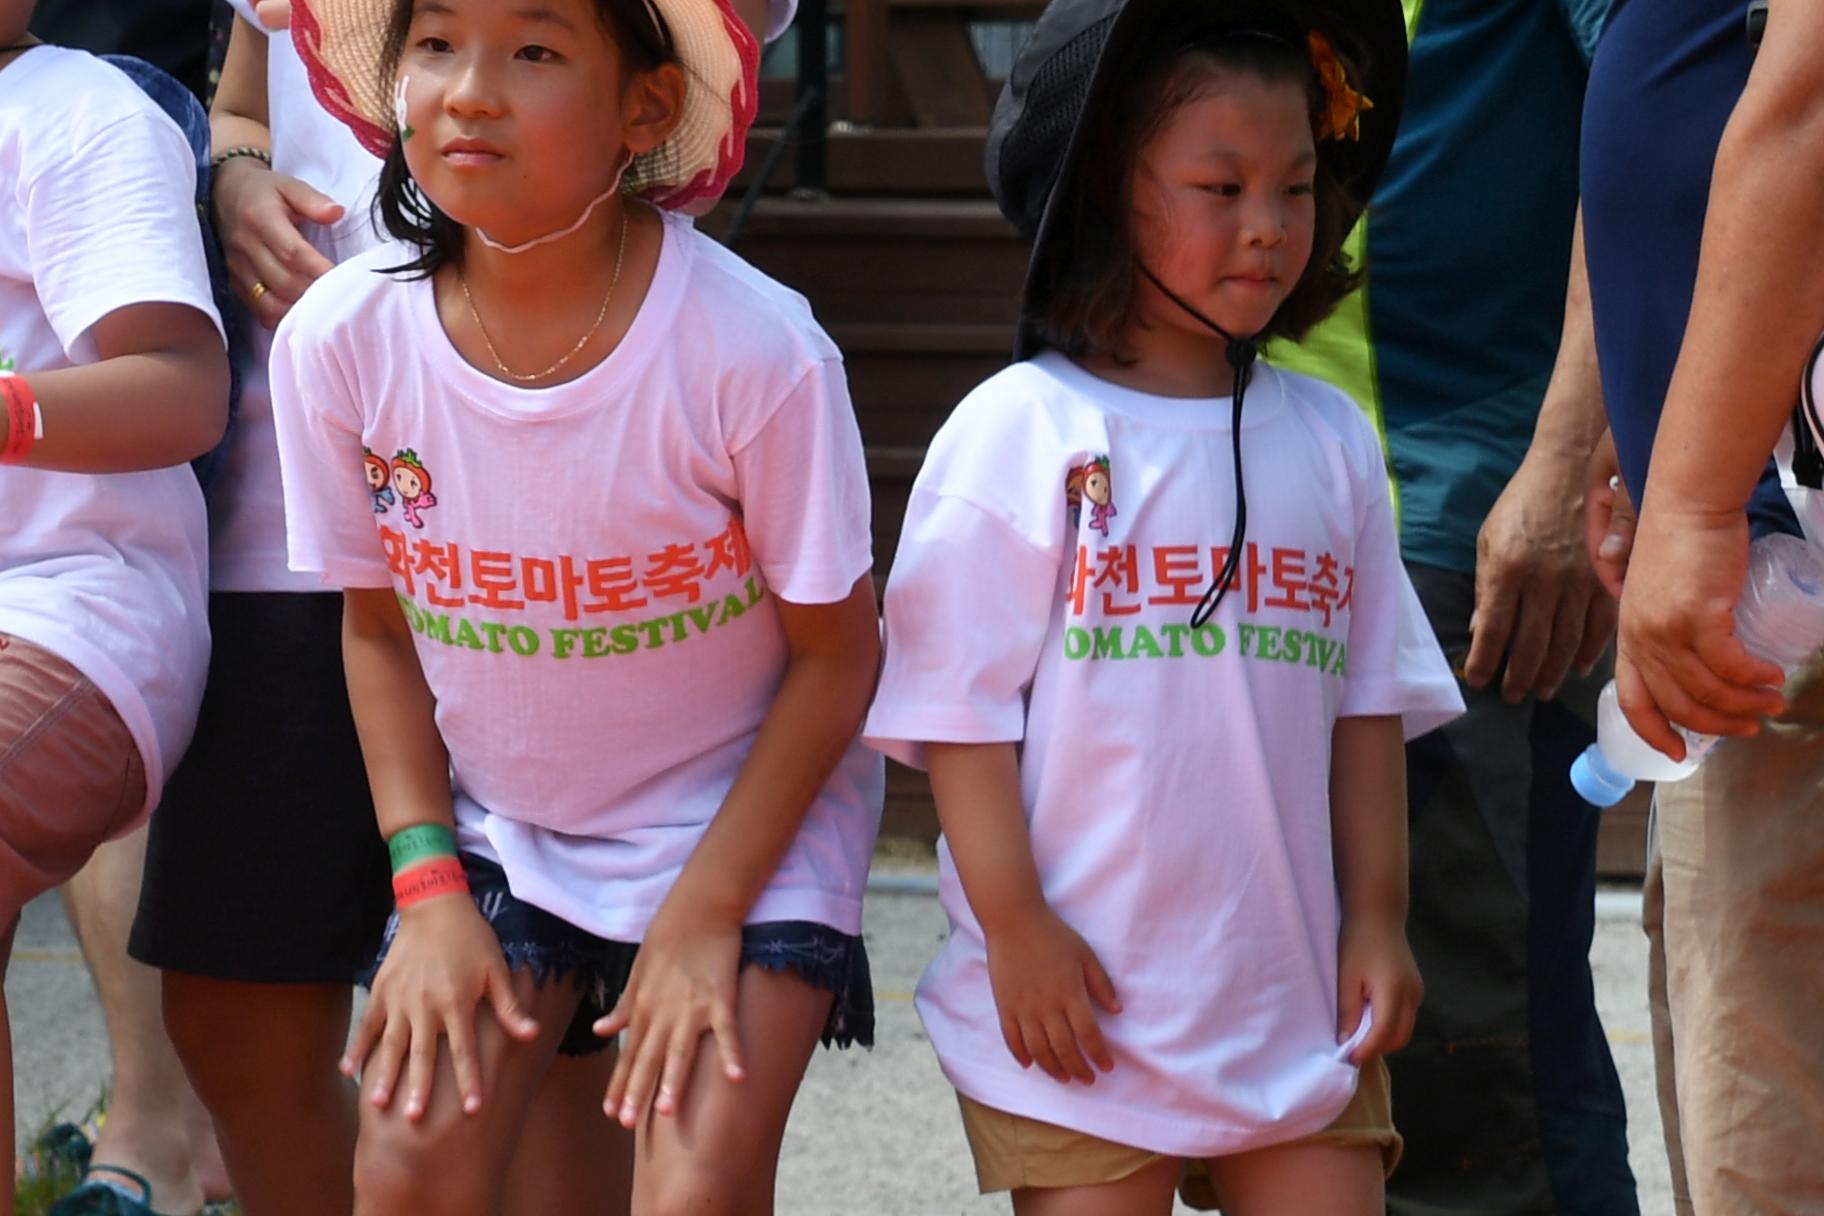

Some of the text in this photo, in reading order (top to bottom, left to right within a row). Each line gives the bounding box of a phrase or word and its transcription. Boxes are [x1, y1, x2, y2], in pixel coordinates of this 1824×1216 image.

[379, 513, 752, 621] 화천토마토축제
[551, 576, 764, 660] FESTIVAL
[1063, 621, 1226, 661] OMATO
